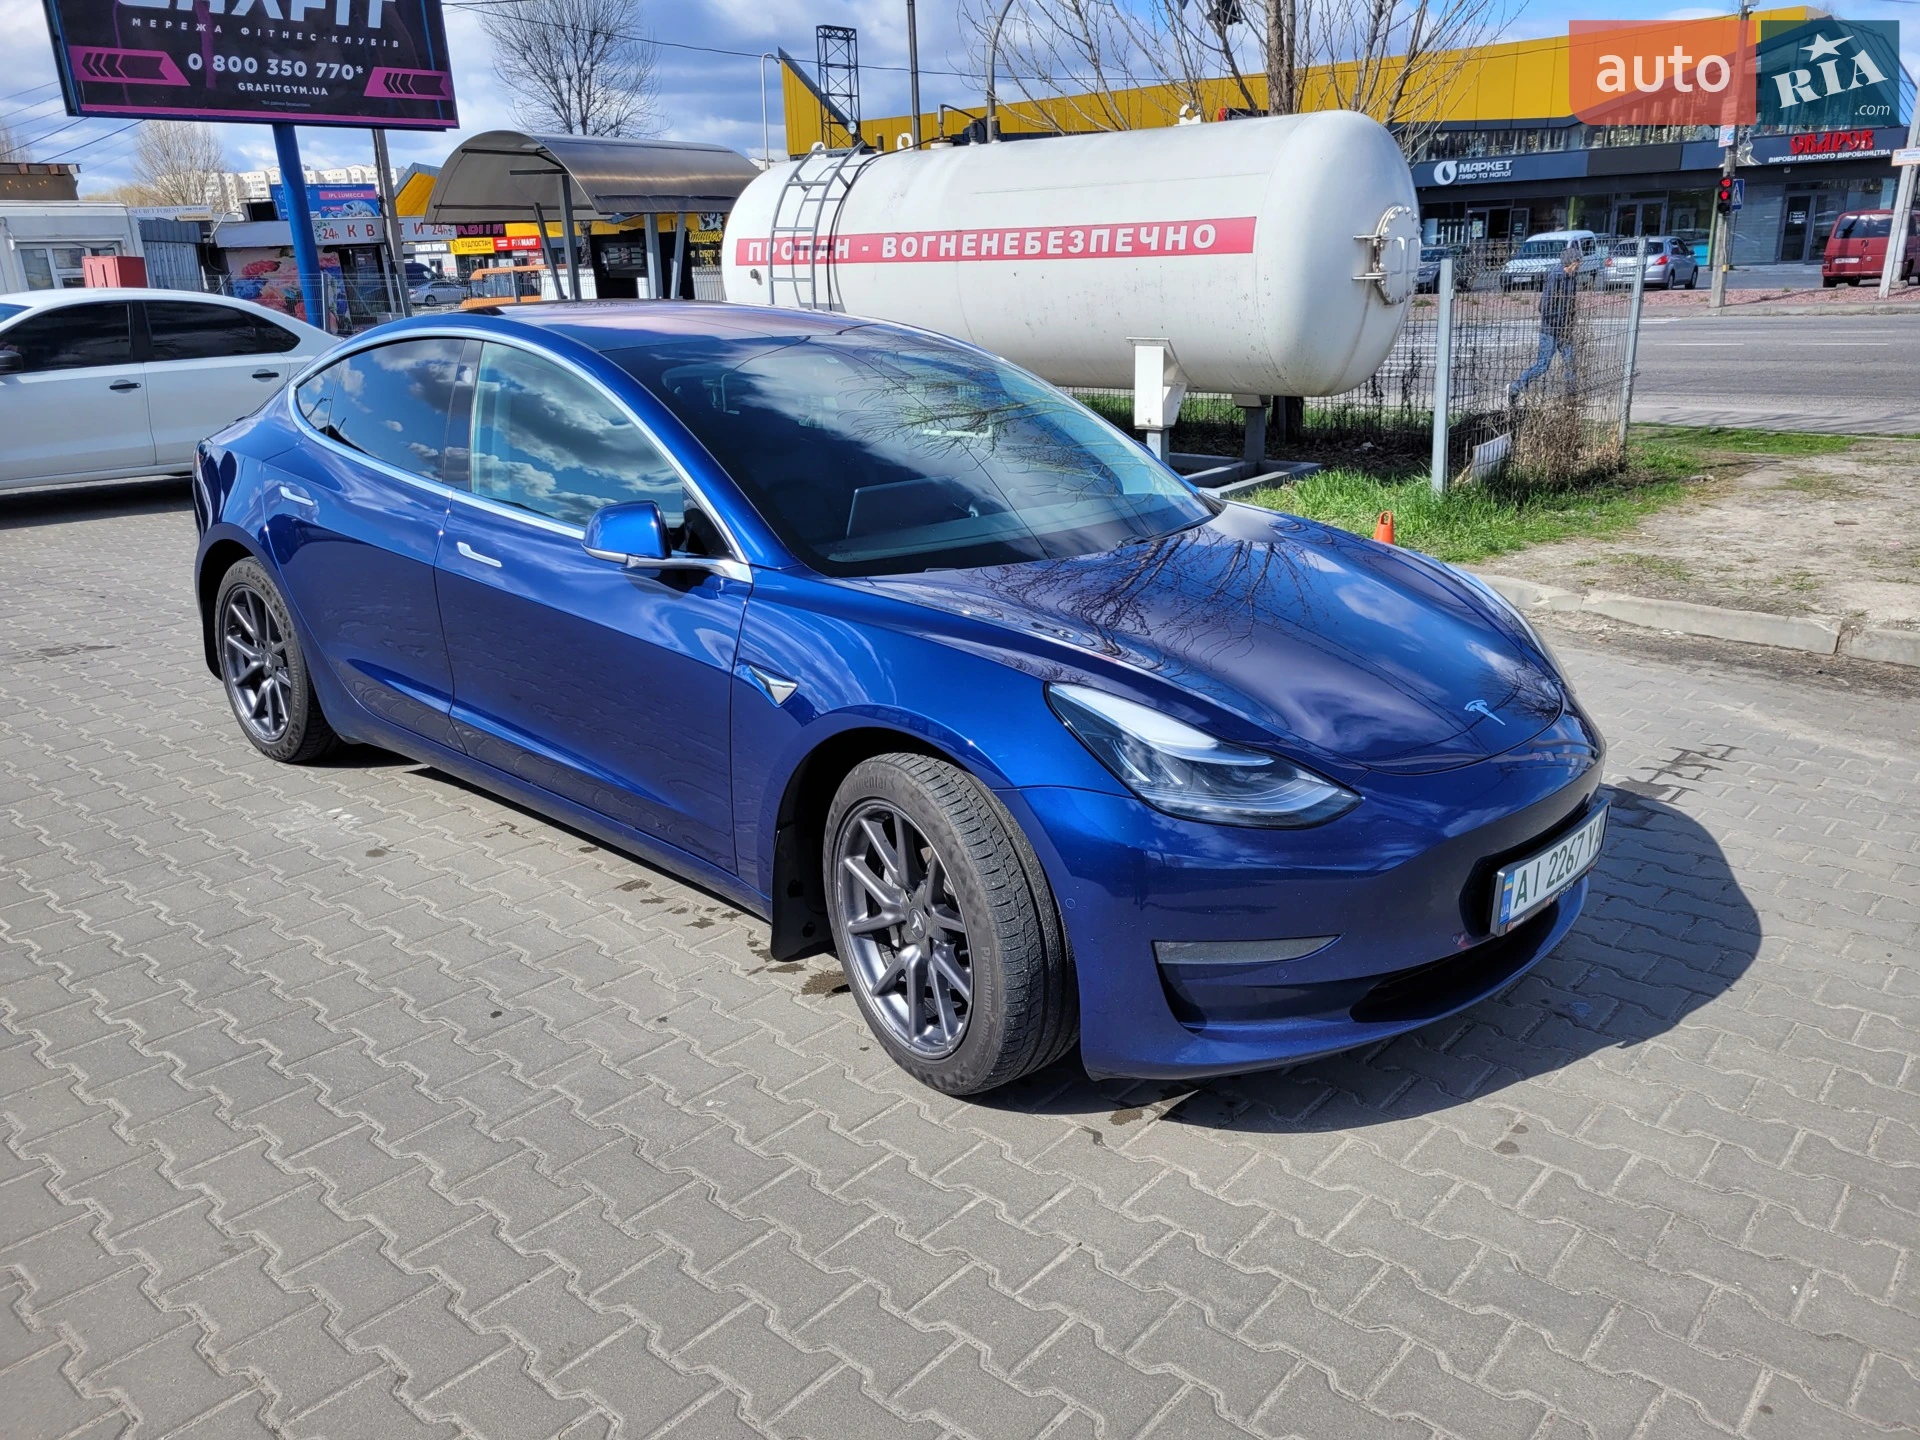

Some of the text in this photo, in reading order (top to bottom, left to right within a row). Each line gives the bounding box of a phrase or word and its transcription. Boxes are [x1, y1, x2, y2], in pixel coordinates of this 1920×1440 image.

[132, 18, 222, 34] МЕРЕЖА
[187, 53, 203, 70] 0
[212, 55, 258, 74] 800
[266, 58, 307, 78] 350
[238, 82, 329, 96] GRAFITGYM.UA
[1768, 156, 1797, 164] ВИРОБИ
[1797, 153, 1836, 162] ВЛАСНОГО
[1837, 149, 1891, 159] ВИРОБНИЦТВА
[1459, 160, 1513, 173] МАРКЕТ
[322, 227, 340, 240] 24h
[882, 223, 1217, 259] ВОГНЕНЕБЕЗПЕЧНО
[1513, 860, 1540, 910] AI
[1546, 831, 1586, 890] 2267
